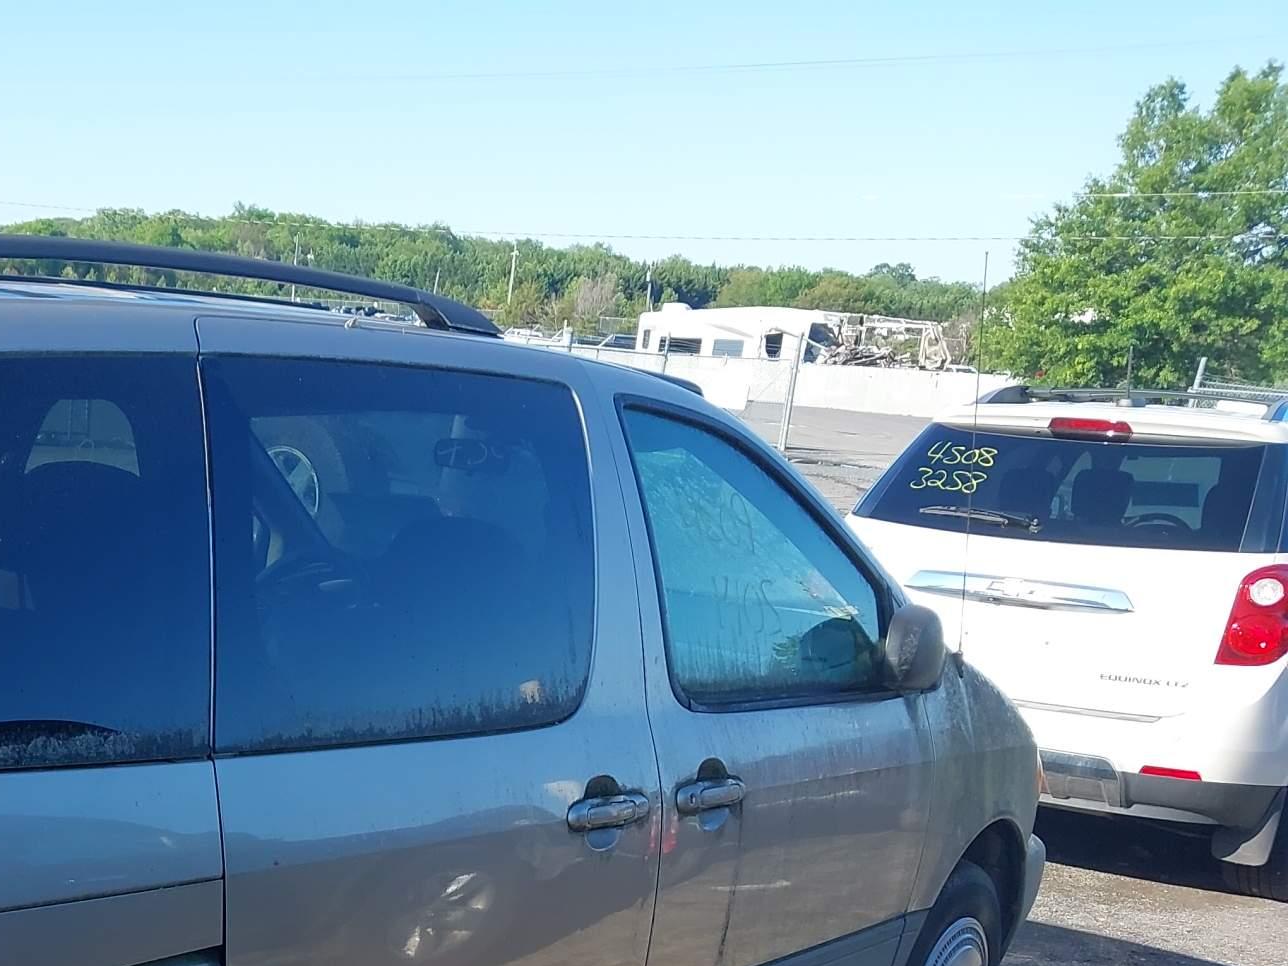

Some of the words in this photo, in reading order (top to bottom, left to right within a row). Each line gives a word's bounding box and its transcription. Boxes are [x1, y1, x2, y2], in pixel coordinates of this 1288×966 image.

[926, 440, 999, 468] 4508
[909, 466, 988, 494] 3258
[1099, 672, 1162, 687] EQUINOX
